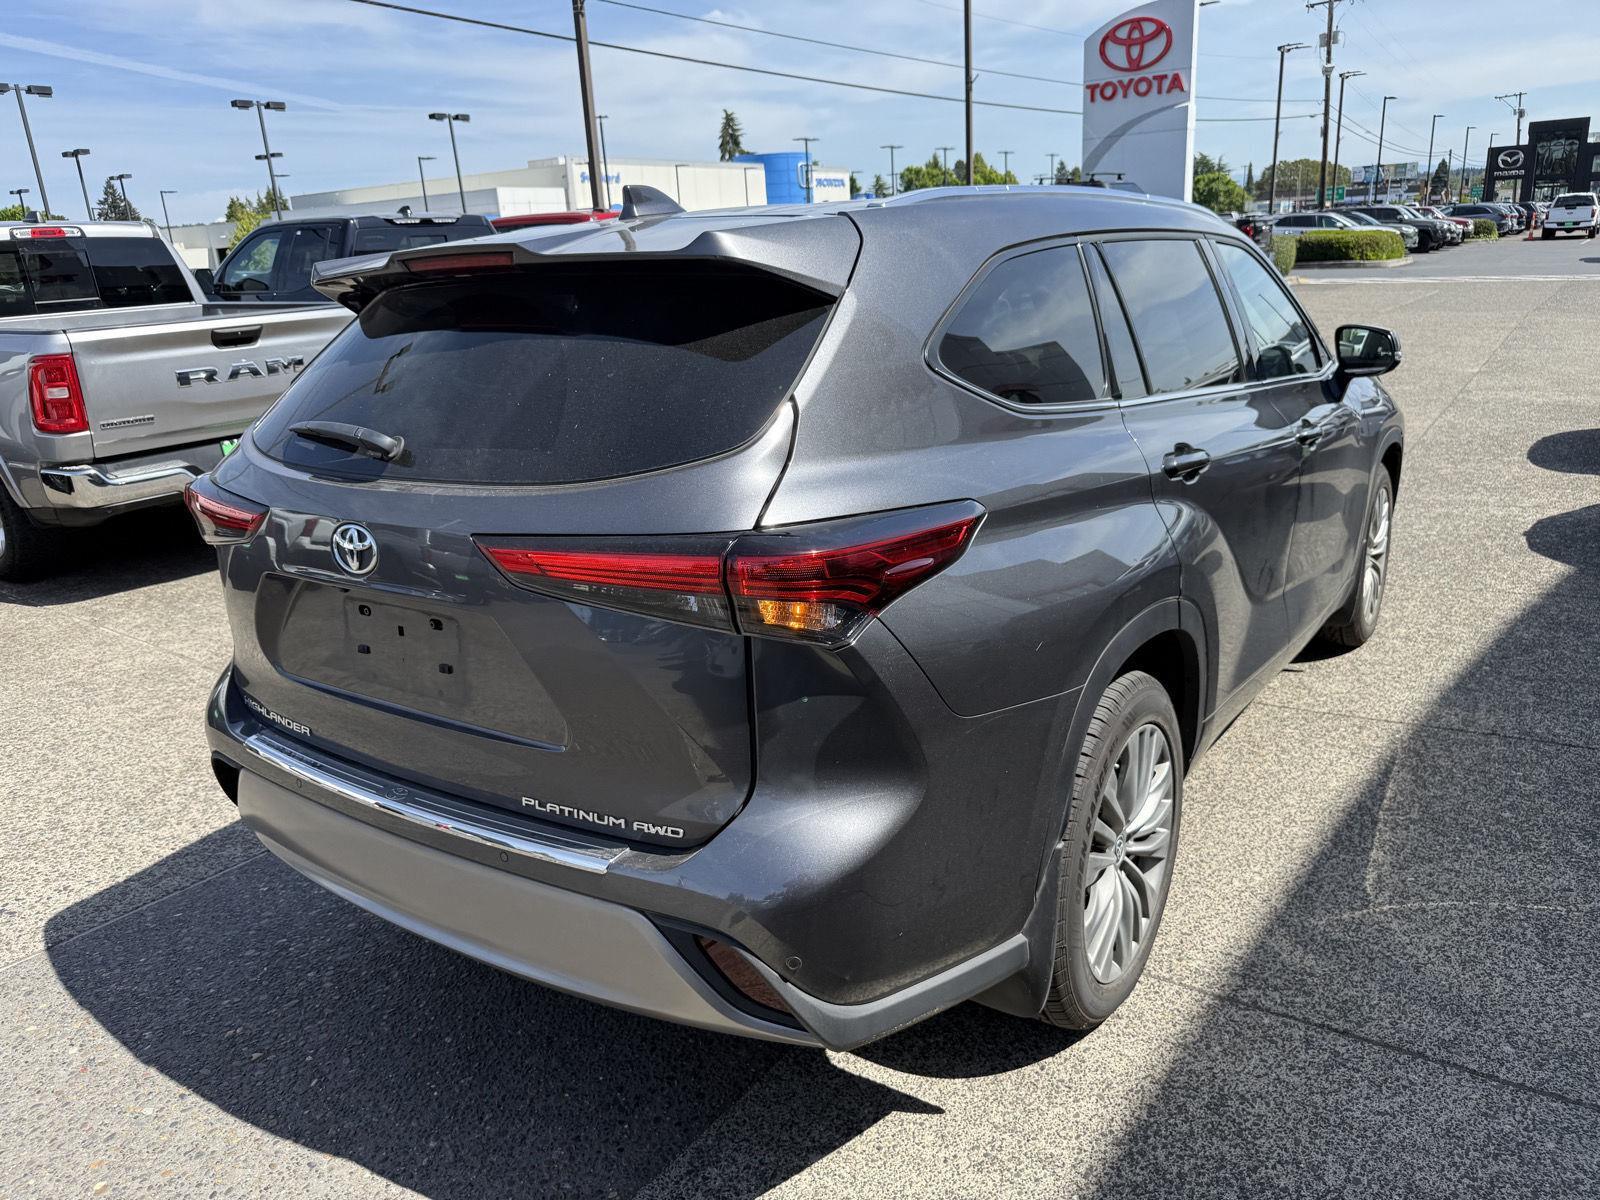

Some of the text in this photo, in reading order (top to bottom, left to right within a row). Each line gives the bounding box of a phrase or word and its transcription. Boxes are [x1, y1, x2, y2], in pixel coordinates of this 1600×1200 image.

[1086, 73, 1185, 103] TOYOTA
[815, 178, 845, 188] HONDA
[175, 355, 304, 388] RAM
[244, 695, 311, 737] HIGHLANDER
[521, 796, 685, 839] PLATINUM AWD
